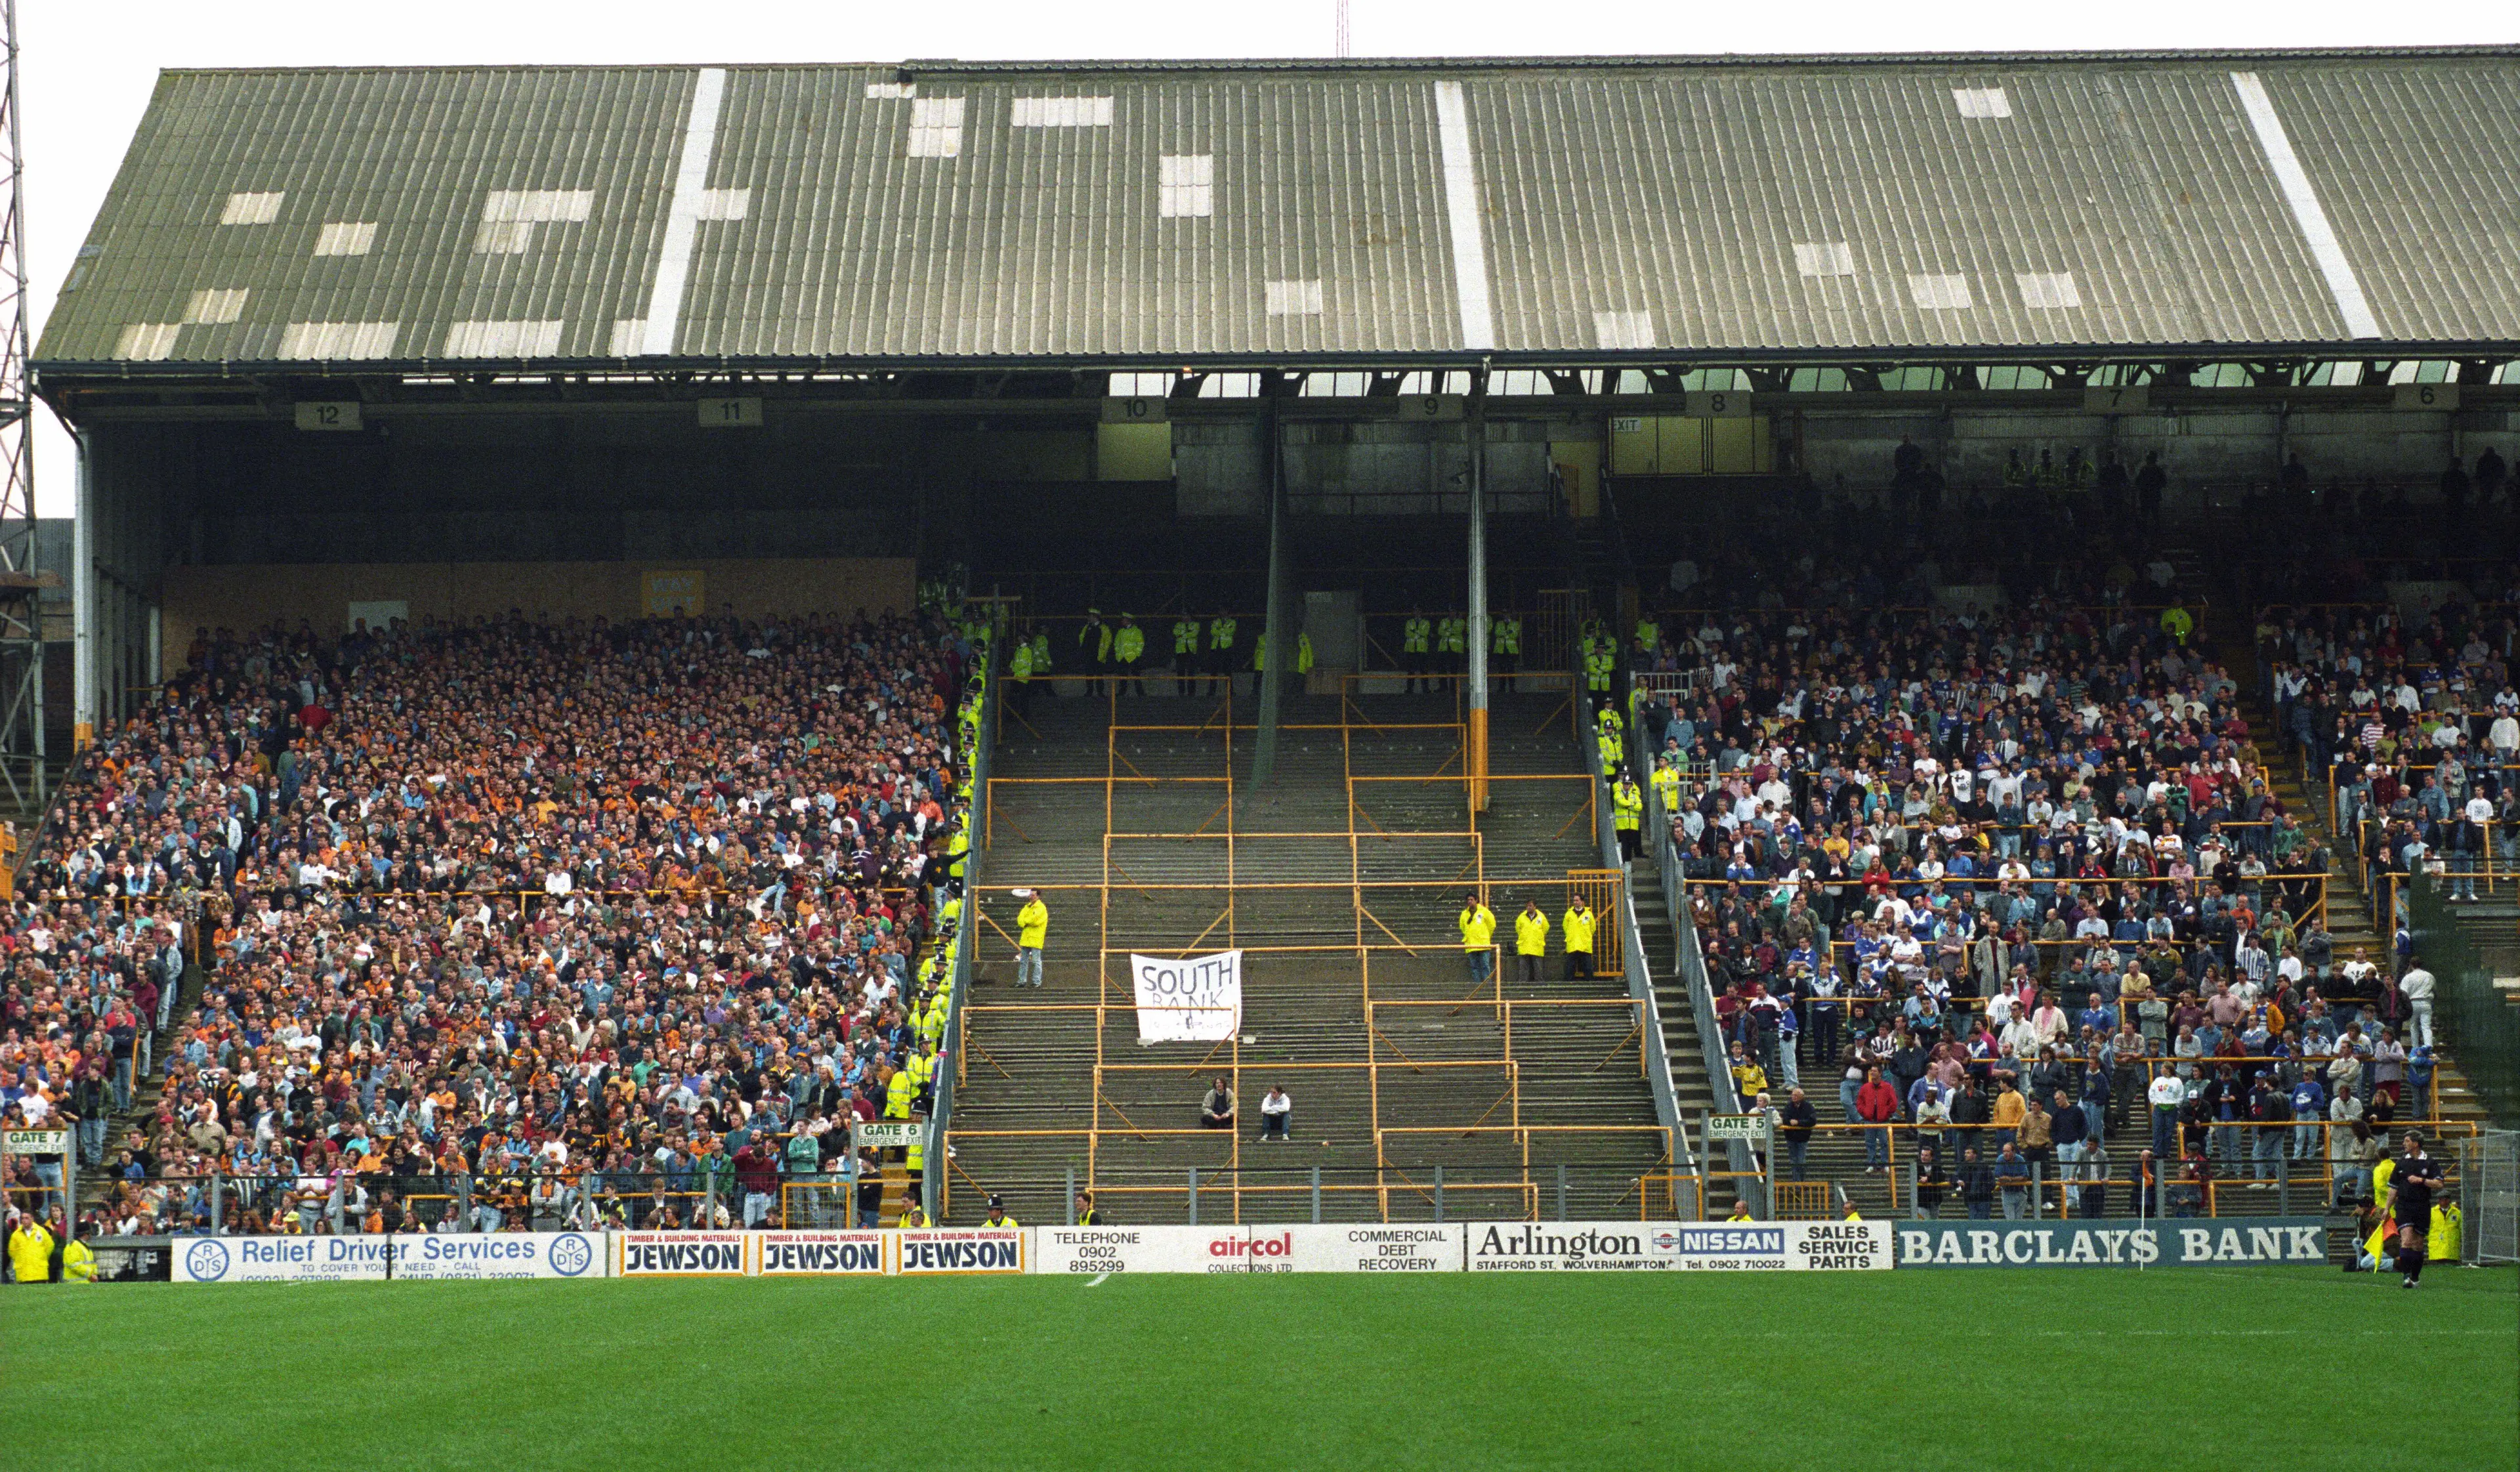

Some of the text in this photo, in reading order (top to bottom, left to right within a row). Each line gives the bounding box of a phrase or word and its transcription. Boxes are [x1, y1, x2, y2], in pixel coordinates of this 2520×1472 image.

[2109, 389, 2122, 407] 7
[2420, 386, 2435, 405] 6
[1123, 398, 1147, 417] 10
[1424, 397, 1438, 415] 9
[1712, 394, 1725, 412] 8
[316, 406, 339, 424] 12
[722, 402, 740, 420] 11
[1142, 956, 1233, 995] SOUTH
[1152, 989, 1224, 1016] BANK
[864, 1124, 917, 1135] GATE 6
[1712, 1118, 1765, 1128] GATE 5
[10, 1132, 62, 1143] GATE 7
[859, 1136, 921, 1145] EMERGENCY EXIT
[627, 1234, 654, 1243] TIMBER
[803, 1234, 837, 1242] BUILDING
[1054, 1232, 1140, 1244] TELEPHONE
[1349, 1230, 1447, 1242] COMMERCIAL
[1808, 1226, 1869, 1239] SALES
[566, 1239, 576, 1250] R
[1209, 1232, 1292, 1257] aircol
[1476, 1225, 1643, 1260] Arlington
[1684, 1231, 1780, 1251] NISSAN
[1799, 1240, 1879, 1254] SERVICE
[1899, 1226, 2324, 1264] BARCLAYS BANK
[203, 1245, 213, 1256] R
[242, 1236, 536, 1262] Relief Driver Services
[904, 1242, 1017, 1269] JEWSON
[1079, 1246, 1116, 1258] 0902
[1379, 1244, 1416, 1256] DEBT
[557, 1254, 583, 1266] D S
[627, 1244, 740, 1270] JEWSON
[765, 1244, 879, 1270] JEWSON
[1809, 1255, 1871, 1269] PARTS
[194, 1260, 222, 1272] D S
[302, 1264, 314, 1272] TO
[321, 1263, 358, 1272] COVER
[364, 1263, 398, 1272] YOUR
[405, 1263, 436, 1271] NEED
[454, 1262, 481, 1271] CALL
[1069, 1260, 1125, 1272] 895299
[1276, 1263, 1292, 1272] LTD
[1358, 1258, 1437, 1271] RECOVERY
[1476, 1260, 1536, 1270] STAFFORD
[1685, 1259, 1786, 1269] Tel. 0902 710022
